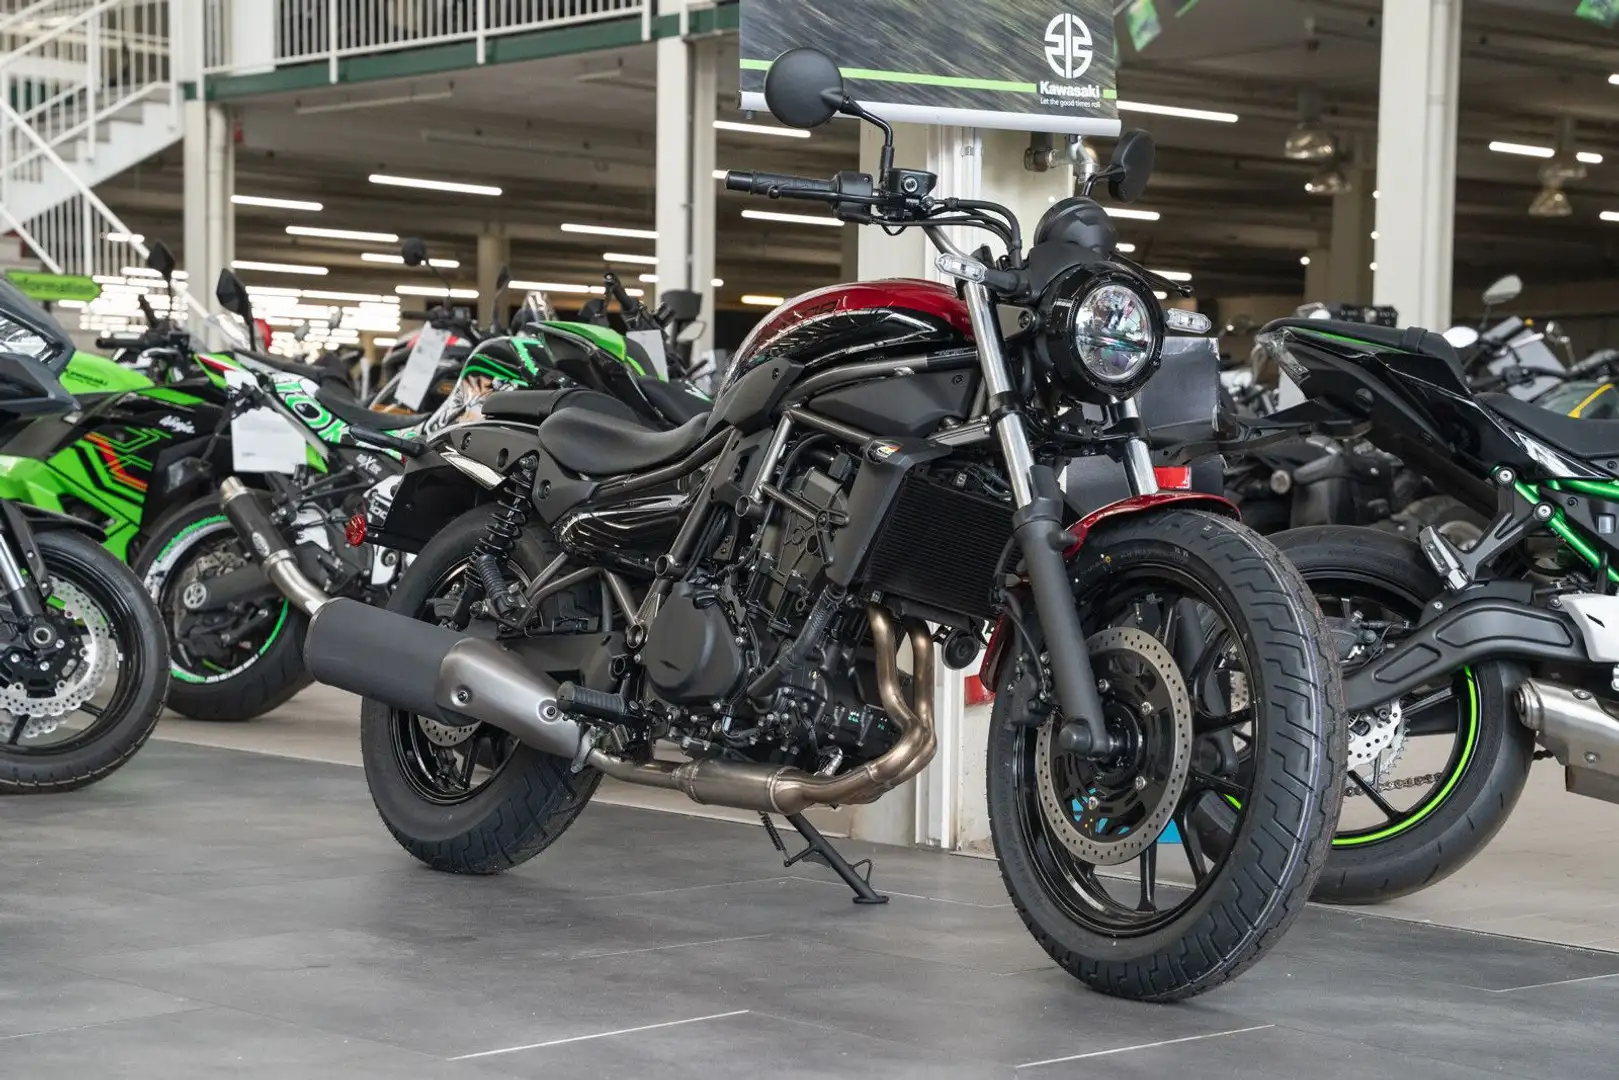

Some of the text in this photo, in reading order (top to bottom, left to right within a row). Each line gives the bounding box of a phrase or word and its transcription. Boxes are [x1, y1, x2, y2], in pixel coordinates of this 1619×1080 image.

[1040, 81, 1100, 98] Kawasaki
[1040, 97, 1050, 105] Let
[1050, 98, 1059, 106] the
[1060, 99, 1075, 108] good
[1075, 99, 1091, 108] times
[159, 415, 196, 434] Ninja
